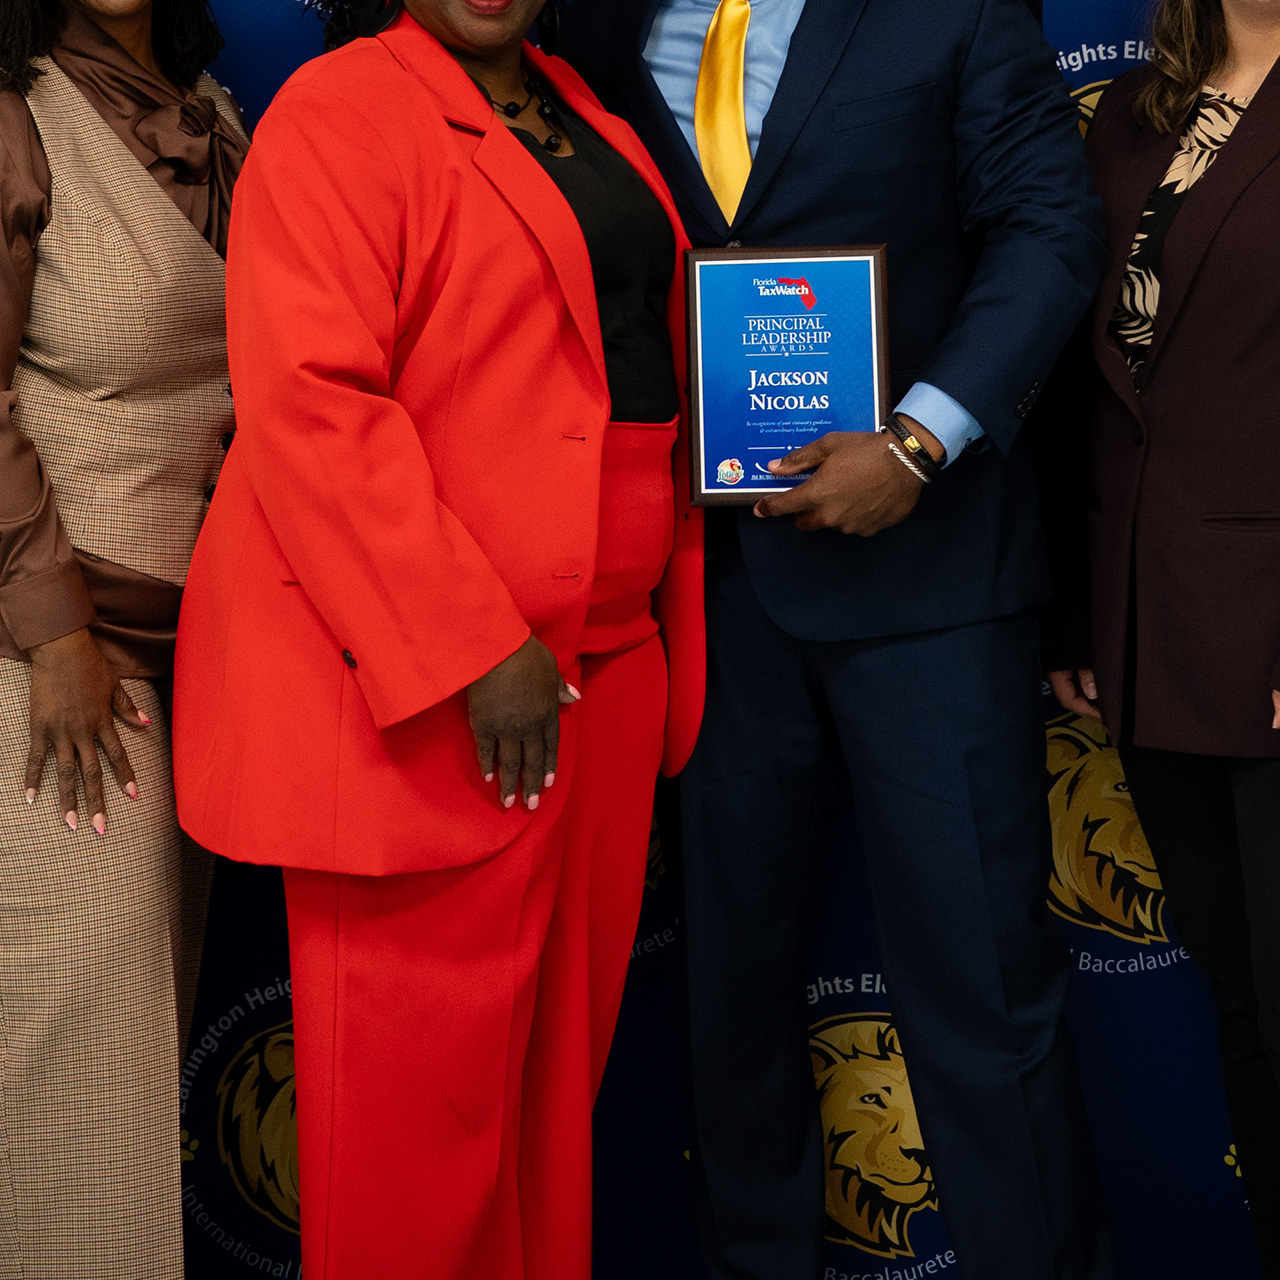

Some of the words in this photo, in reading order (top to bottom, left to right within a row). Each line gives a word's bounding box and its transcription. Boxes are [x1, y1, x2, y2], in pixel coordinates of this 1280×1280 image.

[753, 278, 777, 287] Florida
[757, 284, 809, 297] TaxWatch
[748, 317, 825, 332] PRINCIPAL
[742, 331, 832, 346] LEADERSHIP
[761, 344, 814, 353] AWARDS
[1078, 946, 1191, 974] Baccalaure
